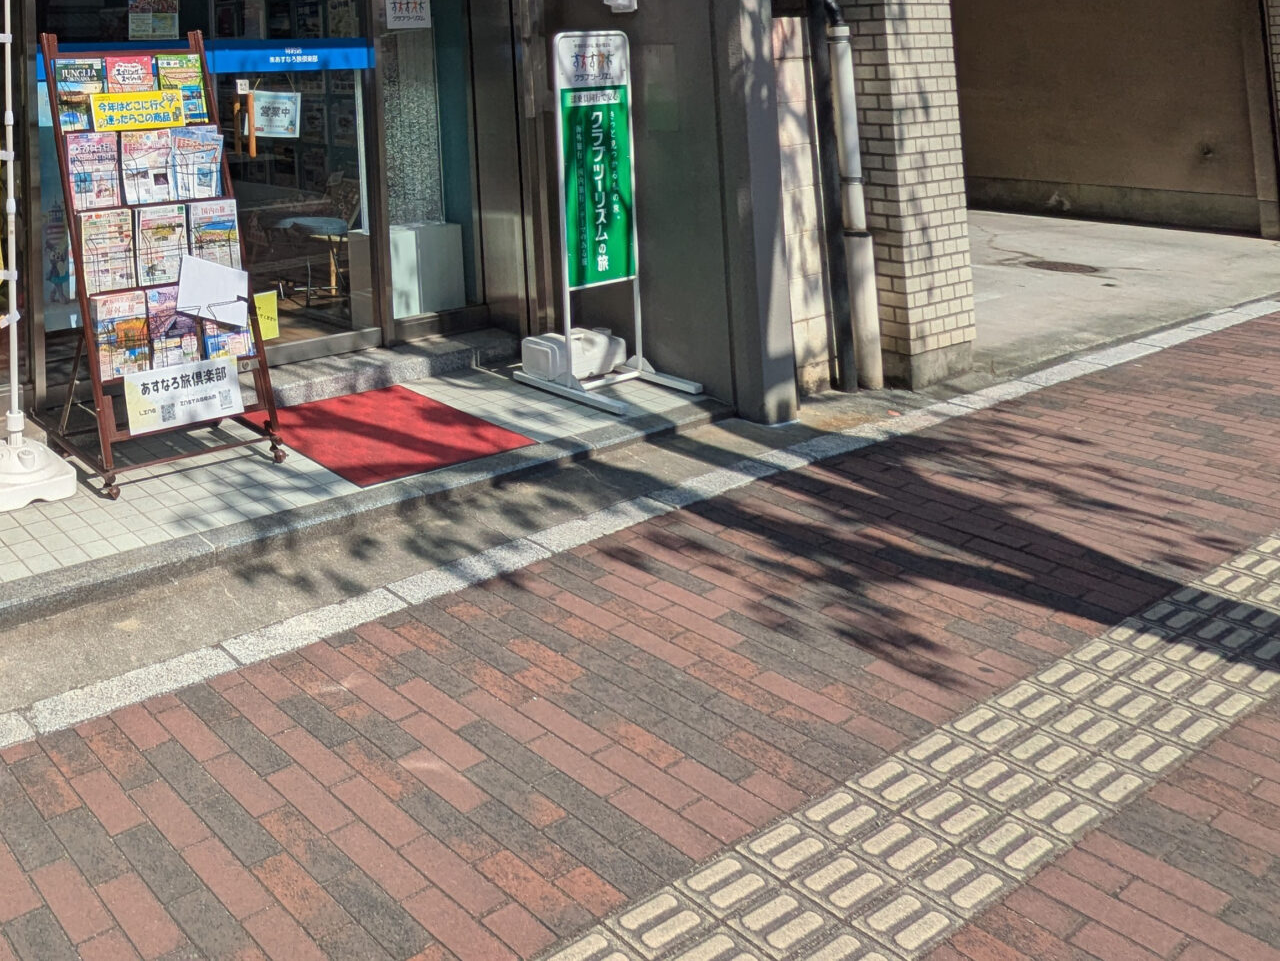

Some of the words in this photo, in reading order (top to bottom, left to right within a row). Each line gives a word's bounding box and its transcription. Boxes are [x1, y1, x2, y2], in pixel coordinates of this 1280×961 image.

[259, 104, 291, 118] 営業中
[140, 366, 227, 396] あすなろ旅倶楽部
